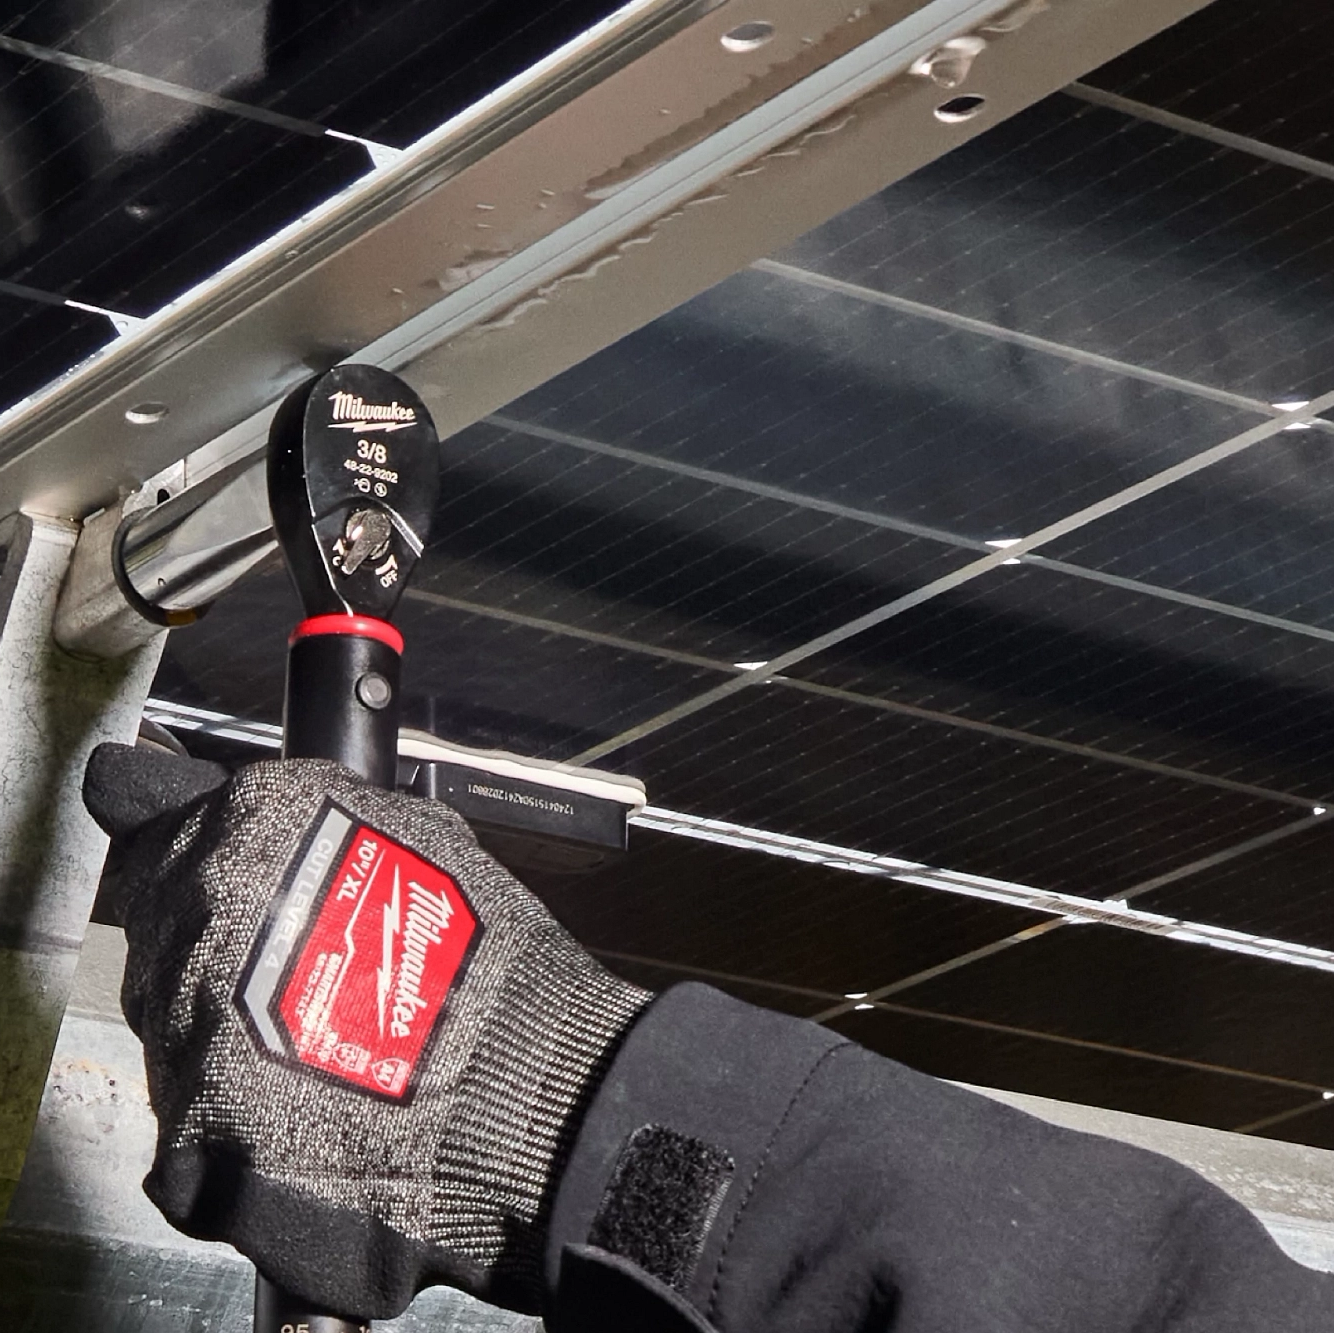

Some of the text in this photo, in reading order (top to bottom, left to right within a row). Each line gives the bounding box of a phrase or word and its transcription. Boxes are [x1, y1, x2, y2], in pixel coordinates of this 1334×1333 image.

[328, 391, 416, 421] Milwaukee
[357, 438, 387, 464] 3/8
[335, 874, 363, 902] XL
[264, 839, 334, 969] CUT LEVEL 4
[389, 880, 455, 1039] Milwaukee
